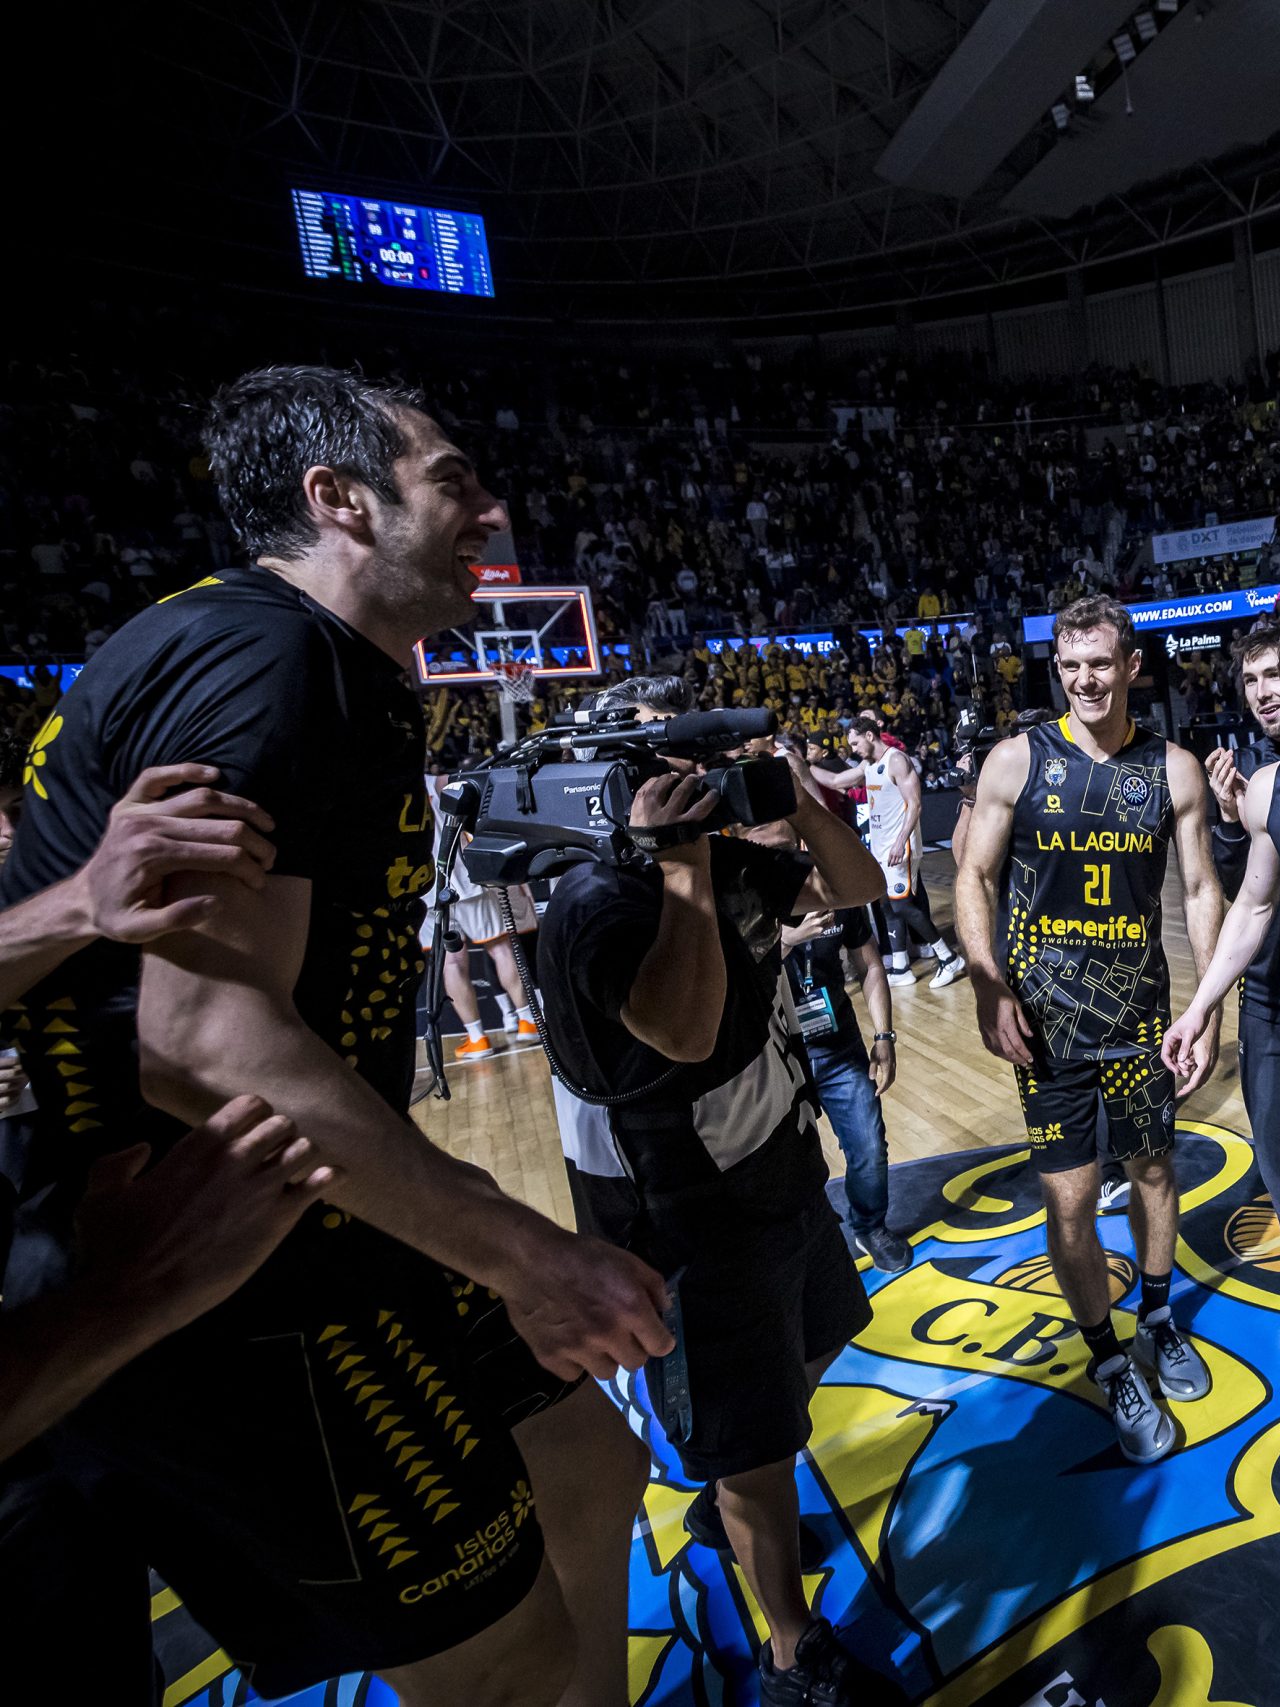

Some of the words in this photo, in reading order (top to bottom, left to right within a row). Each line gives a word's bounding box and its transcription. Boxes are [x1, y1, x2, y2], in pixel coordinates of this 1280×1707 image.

[380, 248, 414, 265] 00:00
[1192, 530, 1220, 545] DXT
[1180, 637, 1192, 648] La
[1193, 633, 1221, 647] Palma
[563, 782, 601, 794] Panasonic
[589, 796, 603, 816] 2
[1036, 830, 1066, 851] LA
[1070, 831, 1153, 854] LAGUNA
[1083, 863, 1112, 906] 21
[1038, 913, 1147, 947] tenerife!
[1041, 937, 1087, 946] awakens
[1092, 939, 1138, 949] emotions
[454, 1510, 510, 1560] Islas
[399, 1525, 515, 1604] Canarias
